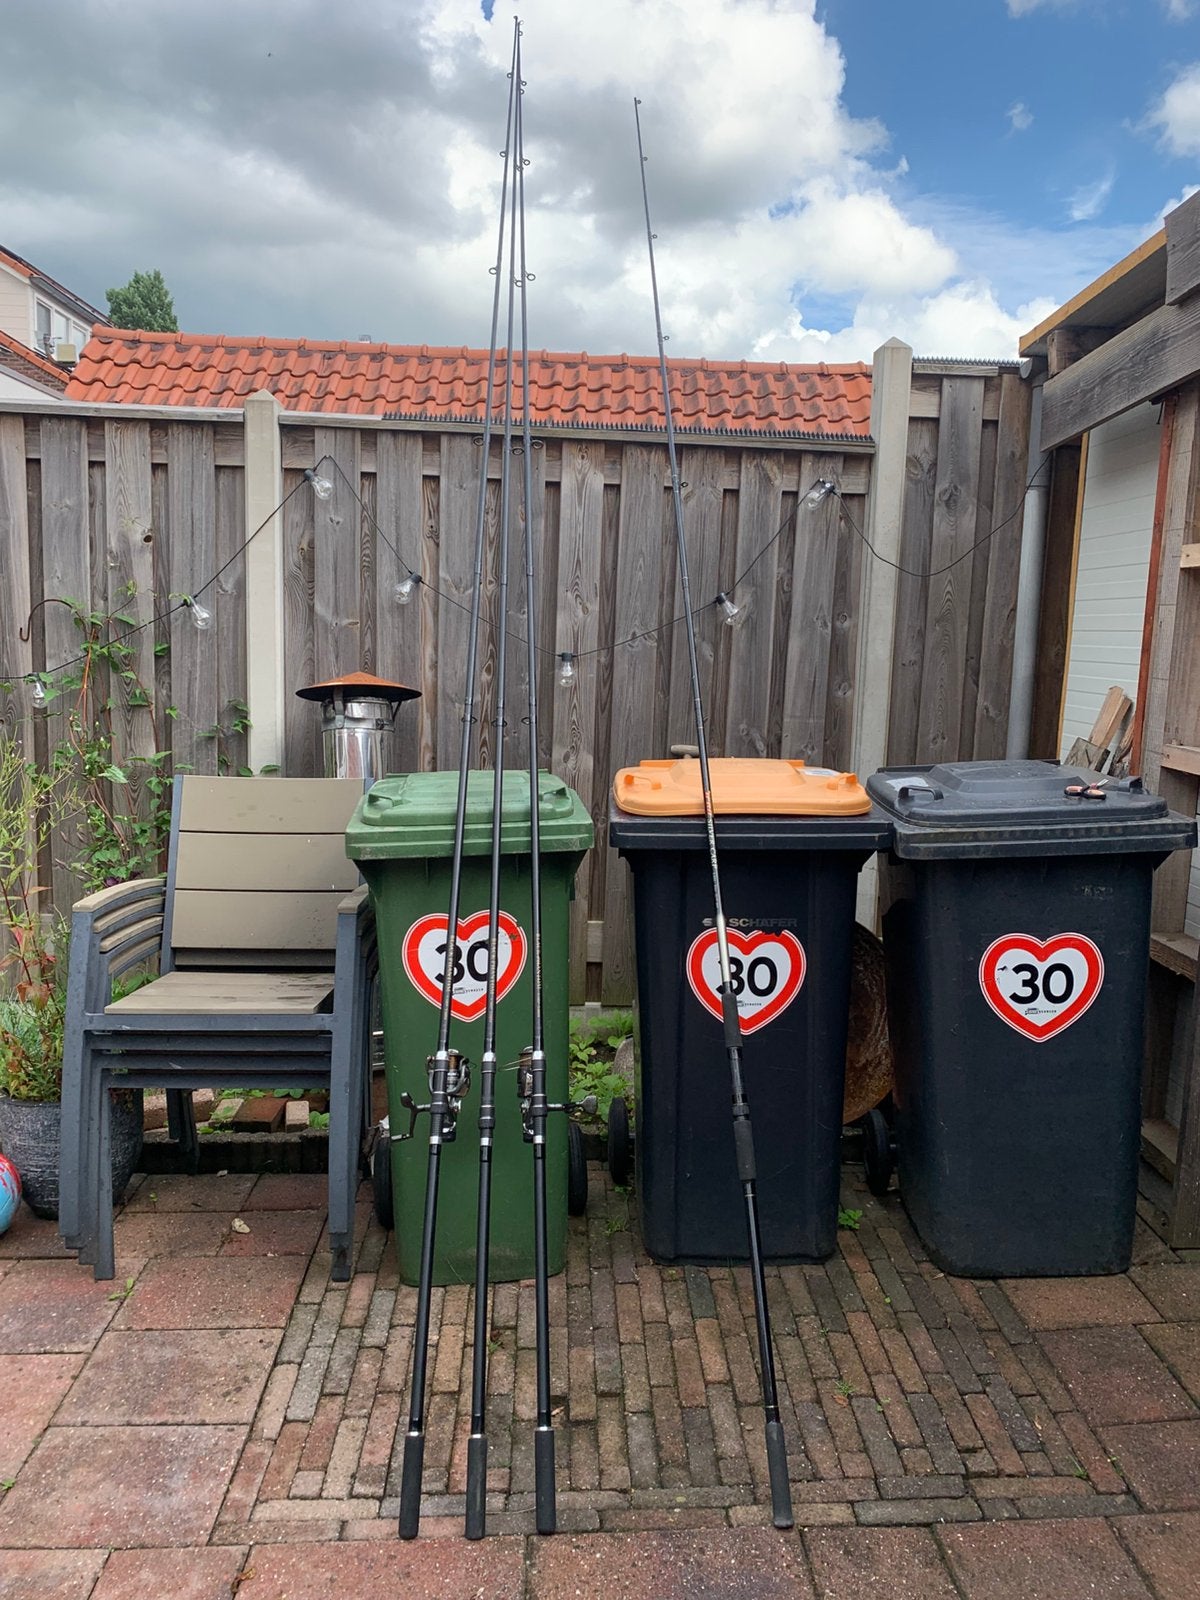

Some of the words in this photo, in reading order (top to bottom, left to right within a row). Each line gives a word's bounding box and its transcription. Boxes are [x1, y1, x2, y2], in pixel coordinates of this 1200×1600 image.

[434, 940, 497, 984] 30
[716, 956, 778, 997] 30
[1009, 963, 1074, 1004] 30
